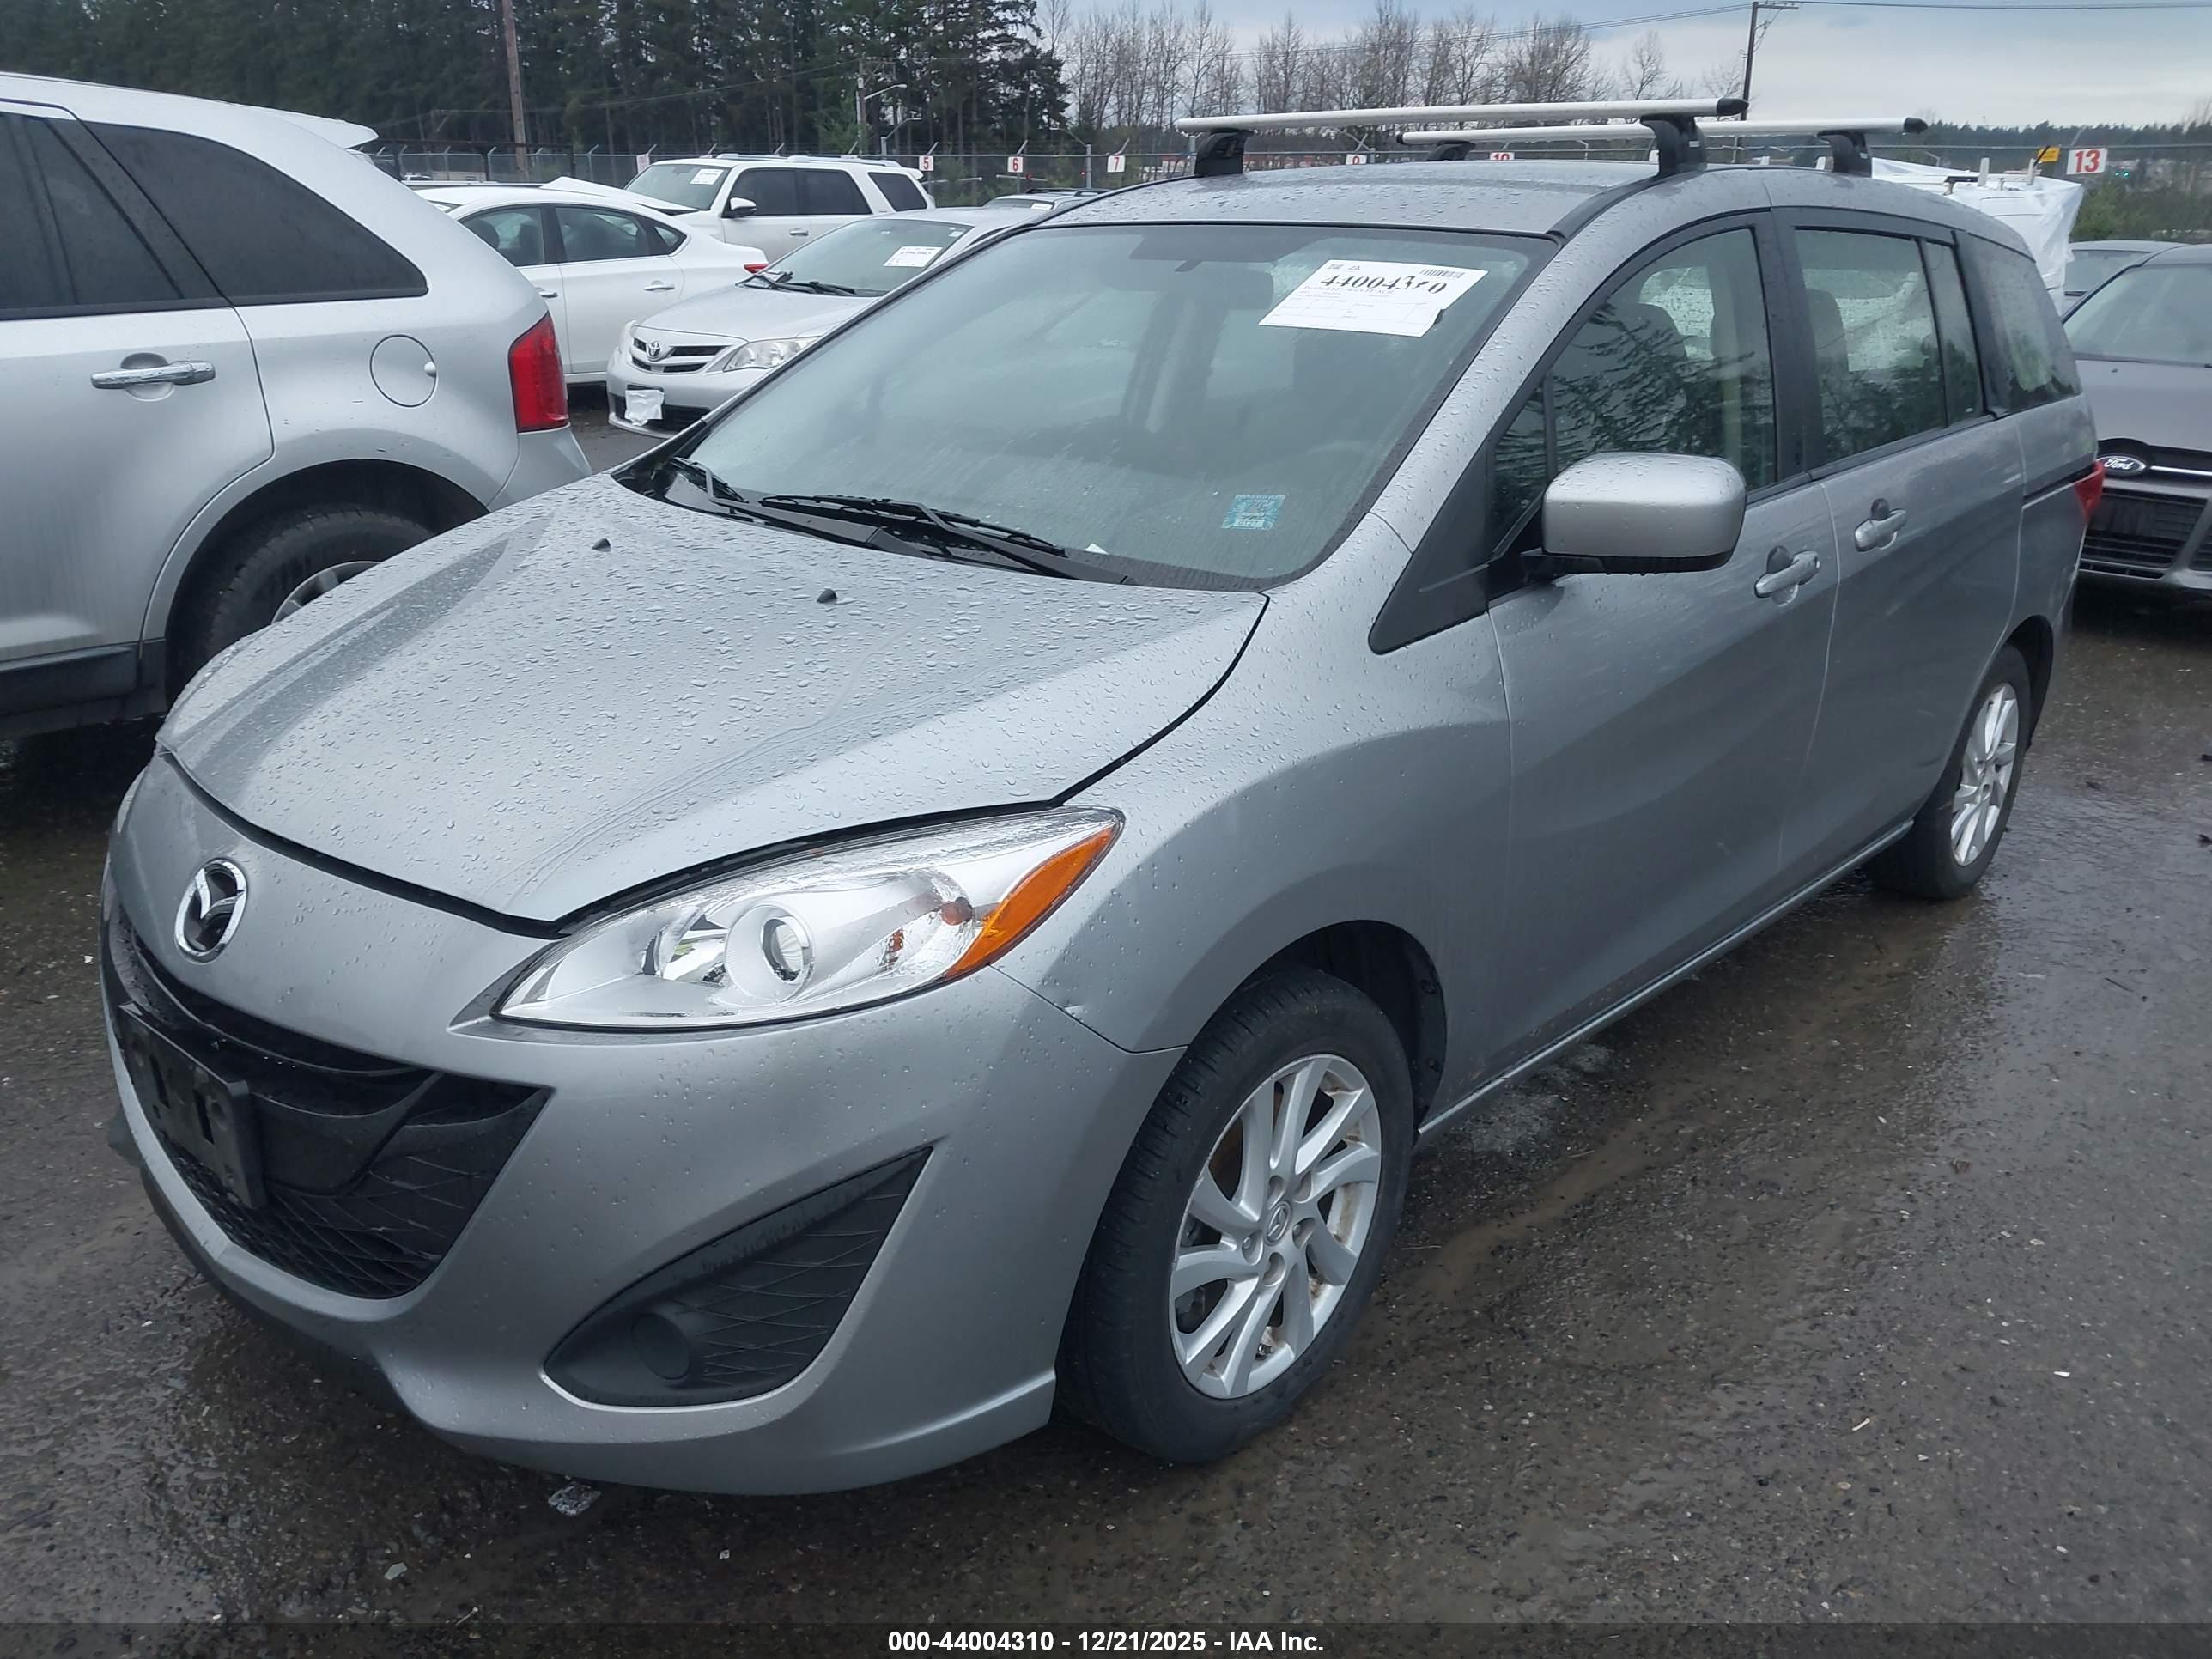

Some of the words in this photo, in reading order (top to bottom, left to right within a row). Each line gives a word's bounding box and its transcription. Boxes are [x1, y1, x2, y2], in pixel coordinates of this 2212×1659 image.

[923, 156, 929, 170] 5
[1012, 157, 1019, 172] 6
[1114, 156, 1120, 172] 7
[2075, 149, 2100, 173] 13
[2104, 458, 2135, 470] Ford
